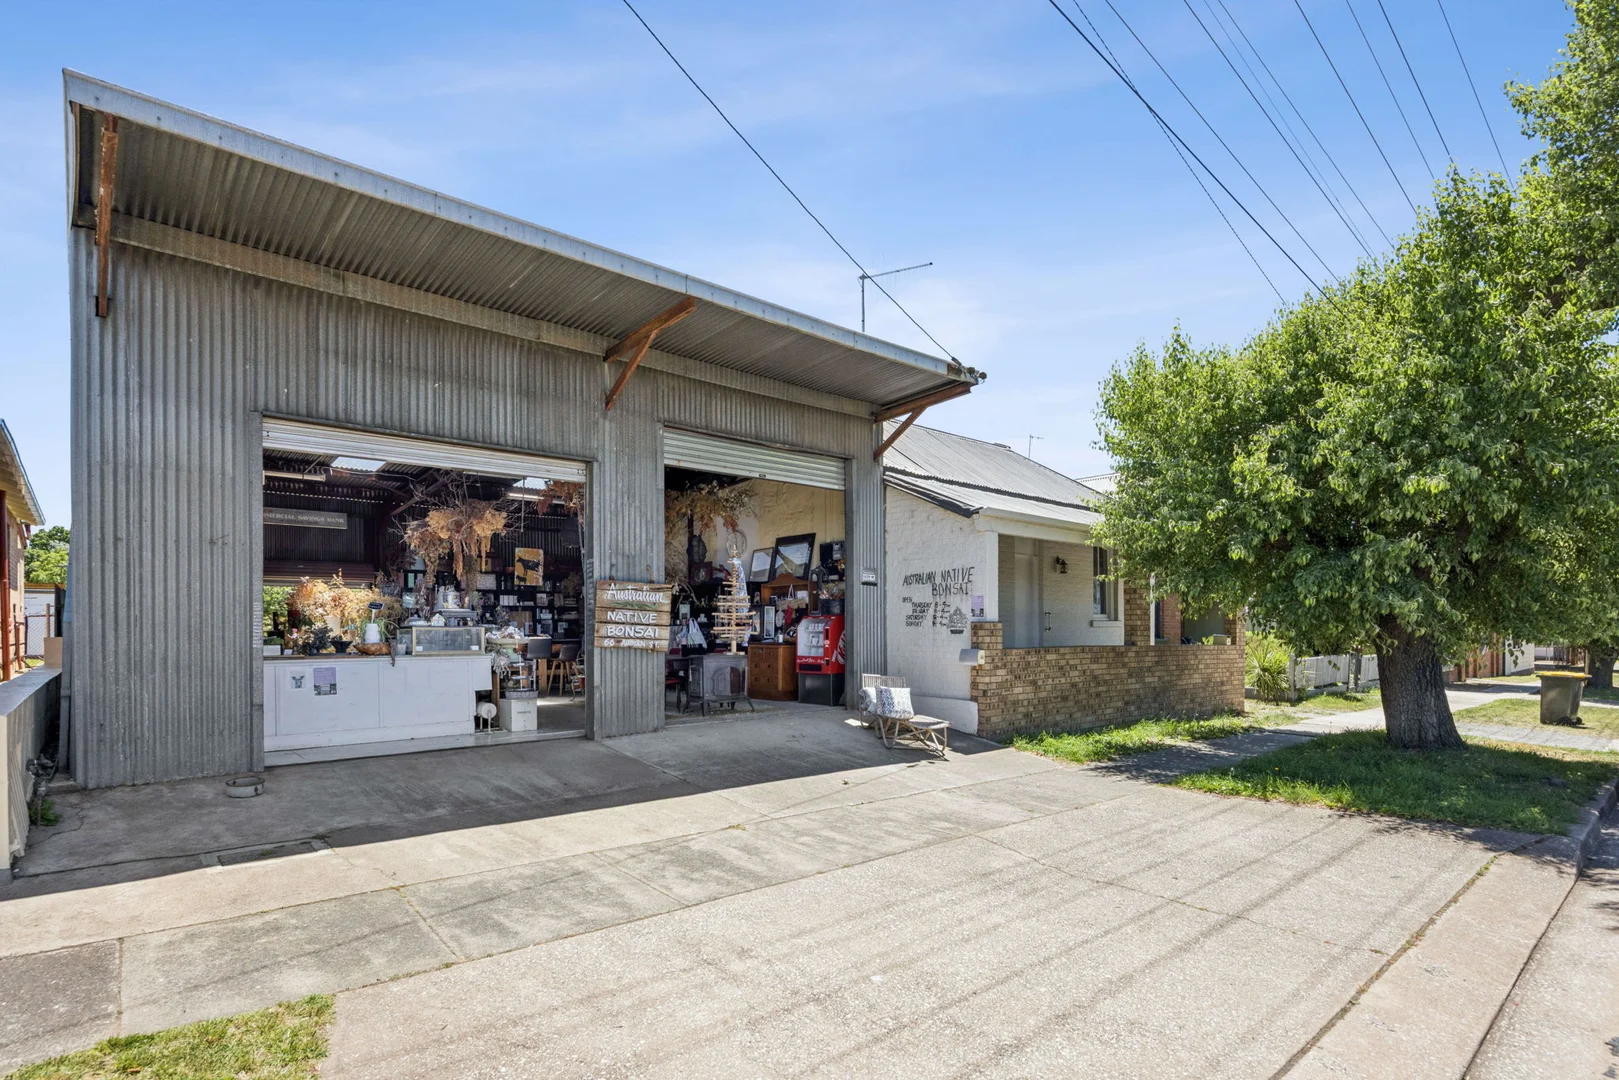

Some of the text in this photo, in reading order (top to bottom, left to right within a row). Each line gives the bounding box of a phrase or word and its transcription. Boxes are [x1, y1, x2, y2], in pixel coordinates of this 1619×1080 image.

[941, 567, 975, 583] NATIVE
[604, 583, 669, 603] Australian
[931, 582, 969, 597] BONSAI
[607, 611, 657, 623] NATIVE
[606, 625, 659, 638] BONSAI
[604, 639, 615, 647] 66
